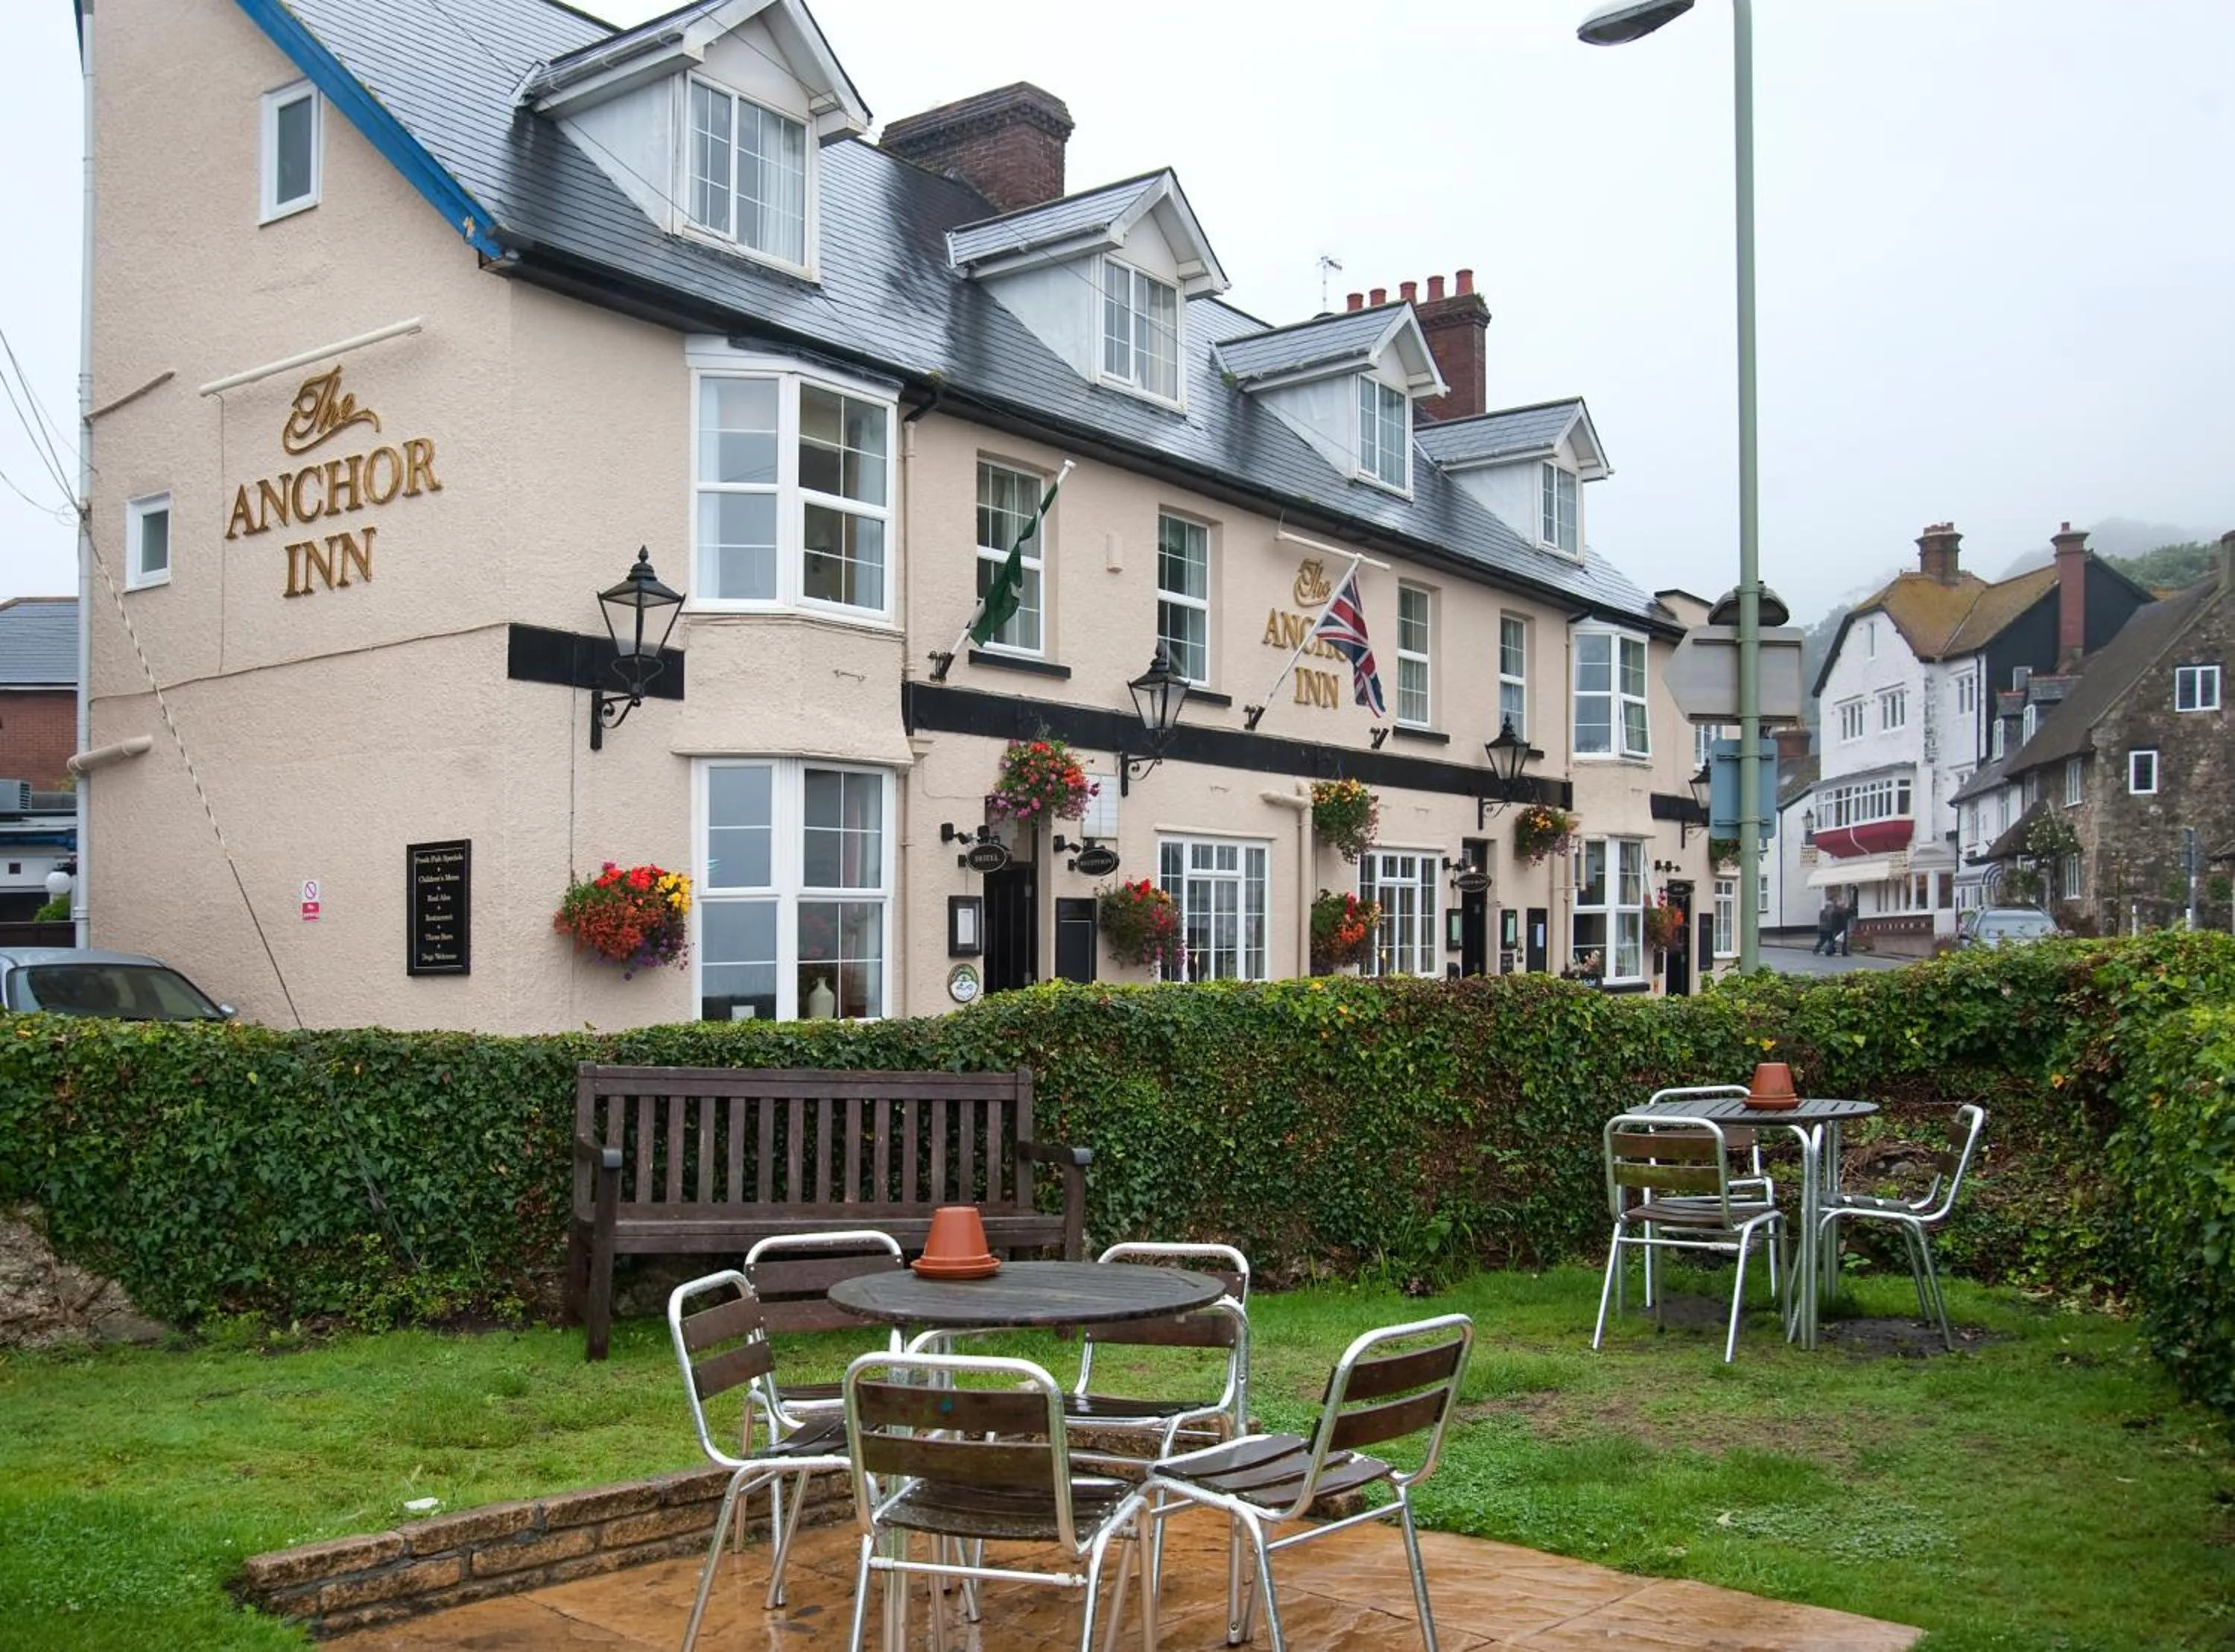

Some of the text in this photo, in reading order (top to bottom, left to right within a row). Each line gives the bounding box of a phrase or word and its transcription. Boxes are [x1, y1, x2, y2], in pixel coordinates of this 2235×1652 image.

[283, 364, 381, 456] The
[225, 438, 442, 539] ANCHOR
[283, 527, 376, 598] INN
[1294, 559, 1331, 607] The
[1294, 667, 1340, 709] INN
